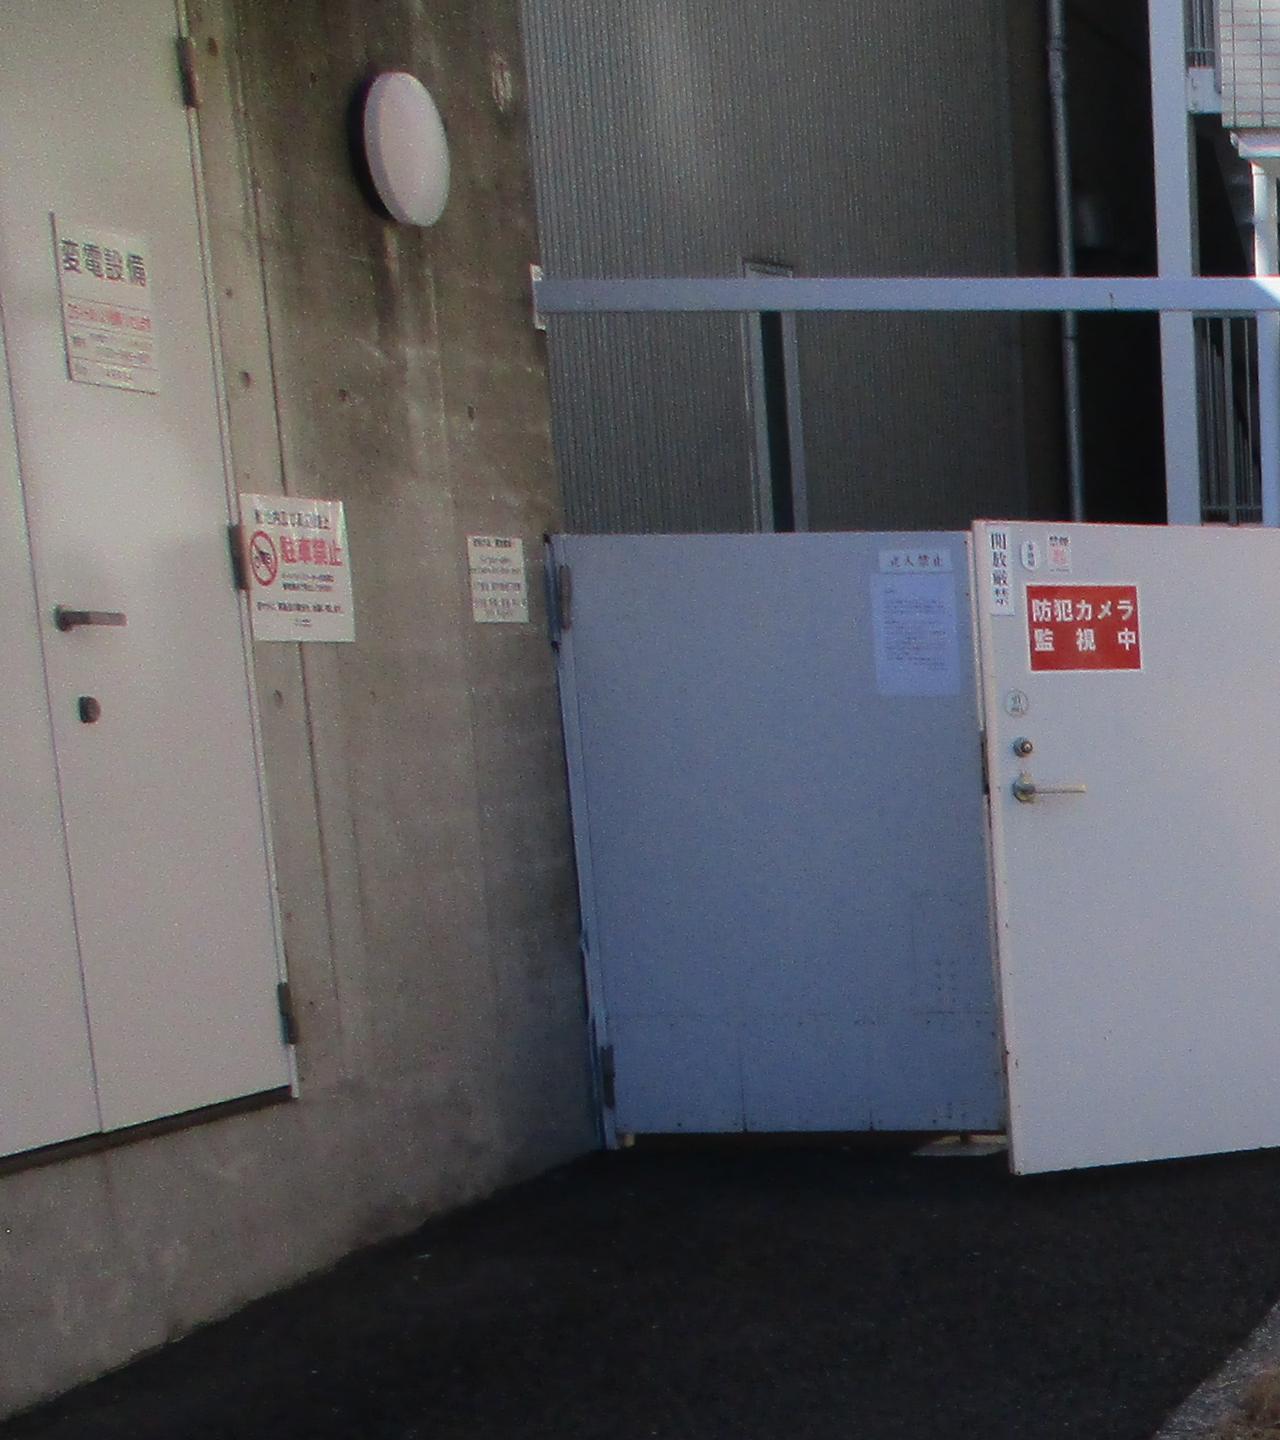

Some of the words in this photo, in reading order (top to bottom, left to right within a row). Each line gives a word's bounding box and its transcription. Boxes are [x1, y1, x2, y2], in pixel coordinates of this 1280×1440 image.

[280, 535, 344, 567] 駐車禁止
[990, 532, 1009, 606] 開放厳禁
[1031, 598, 1135, 623] 防犯カメラ
[1033, 627, 1137, 653] 監視中
